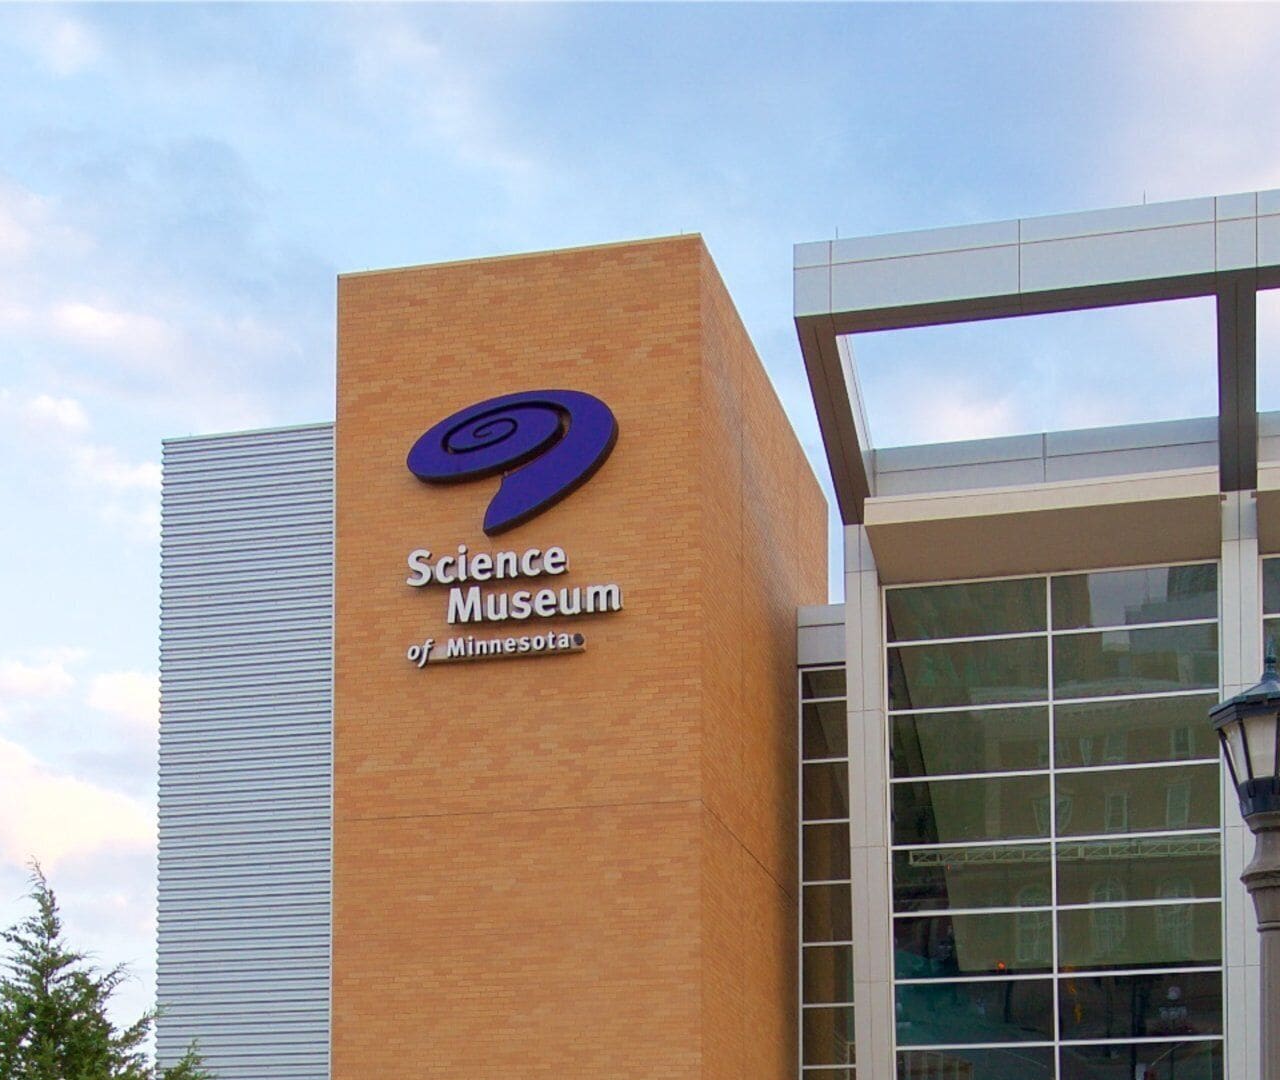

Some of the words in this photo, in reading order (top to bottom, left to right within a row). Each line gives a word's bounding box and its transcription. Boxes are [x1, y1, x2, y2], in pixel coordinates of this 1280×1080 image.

[406, 543, 568, 587] Science
[447, 582, 622, 624] Museum
[407, 638, 435, 668] of
[447, 631, 570, 658] Minnesota
